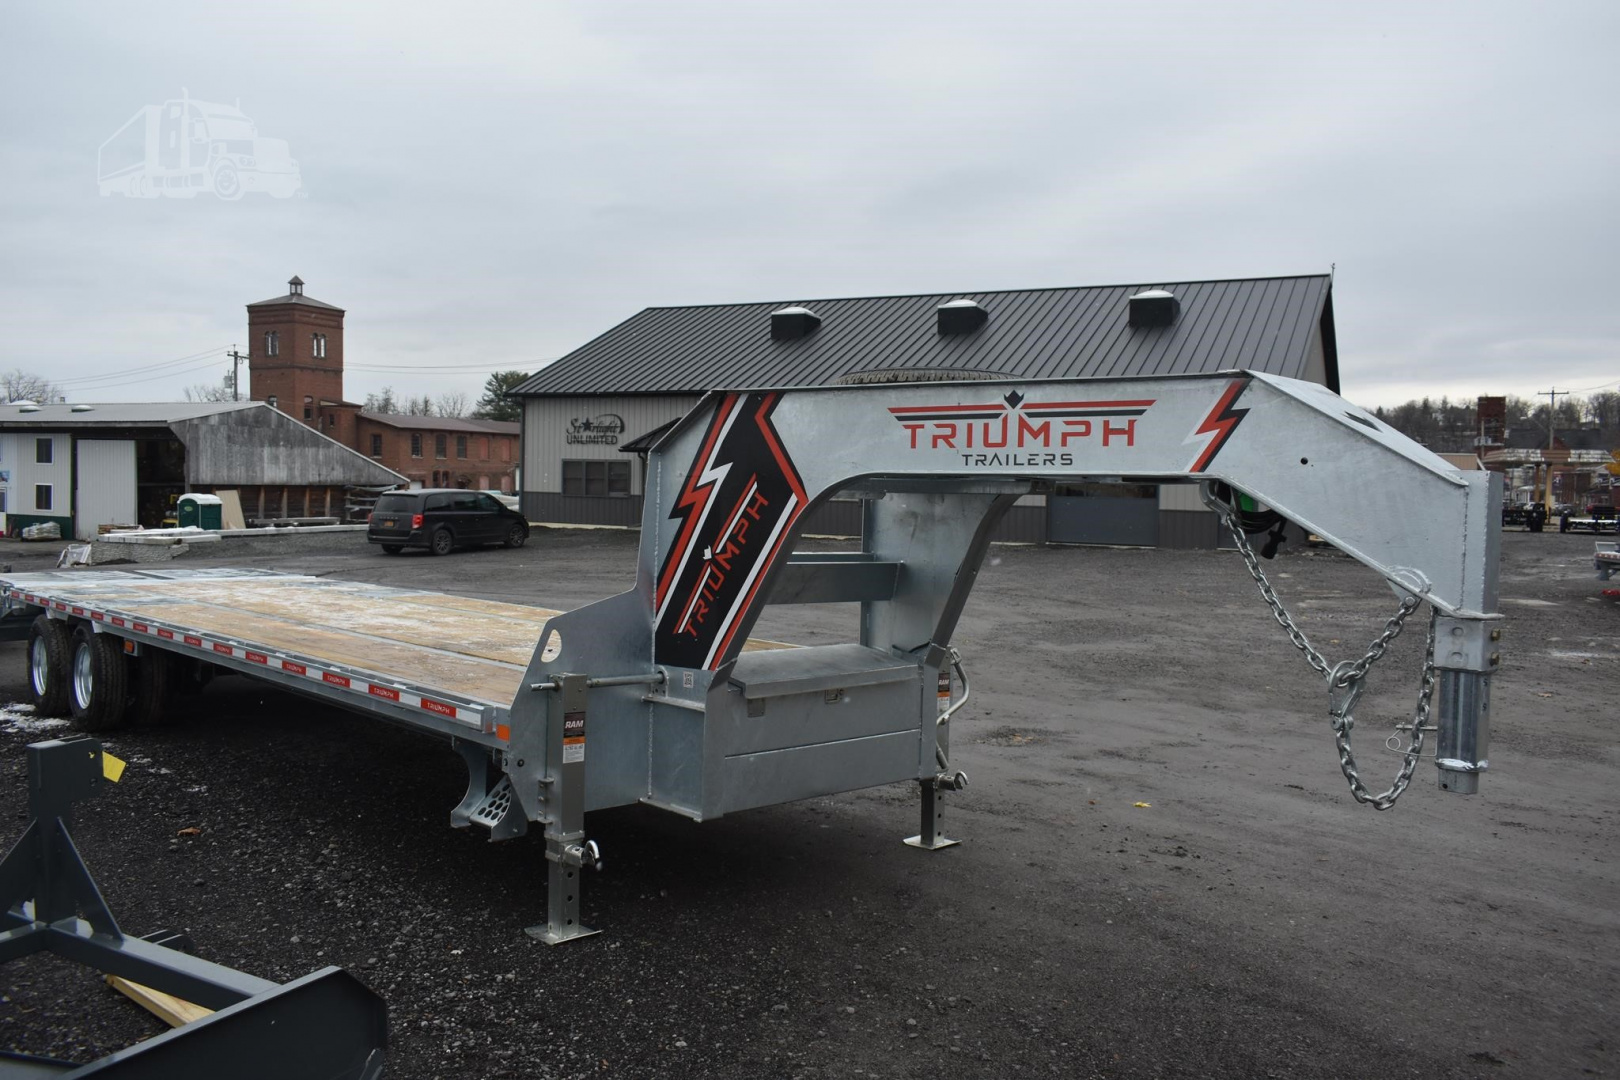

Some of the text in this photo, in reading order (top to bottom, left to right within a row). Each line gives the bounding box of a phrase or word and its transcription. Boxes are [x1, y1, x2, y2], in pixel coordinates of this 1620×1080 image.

[902, 413, 1138, 449] TRIUMPH
[566, 435, 618, 445] UNLIMITED
[961, 452, 1073, 466] TRAILERS
[684, 490, 769, 637] TRIUMPH
[427, 702, 450, 714] TRIUMPH
[565, 720, 584, 729] RAM
